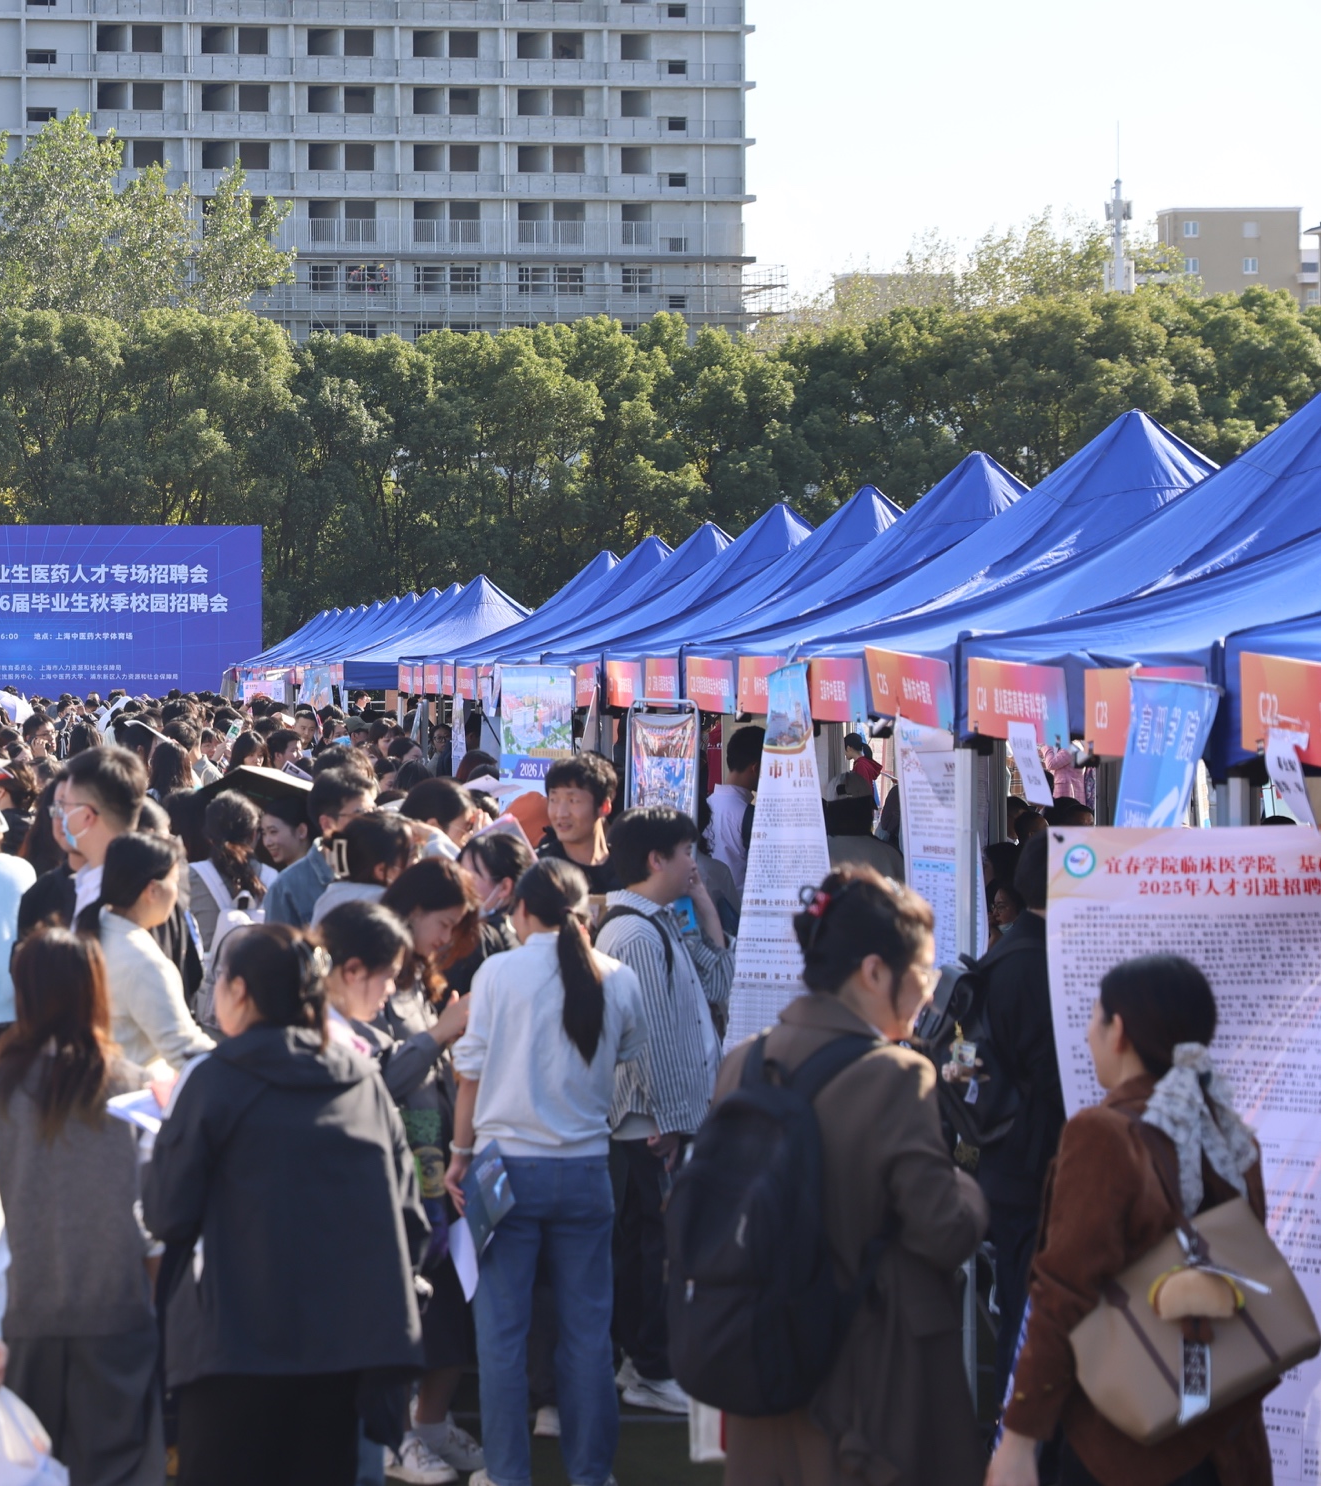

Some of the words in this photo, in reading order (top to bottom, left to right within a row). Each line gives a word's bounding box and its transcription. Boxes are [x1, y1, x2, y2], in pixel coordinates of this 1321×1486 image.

[1104, 854, 1321, 875] 宜春学院临床医学院、基
